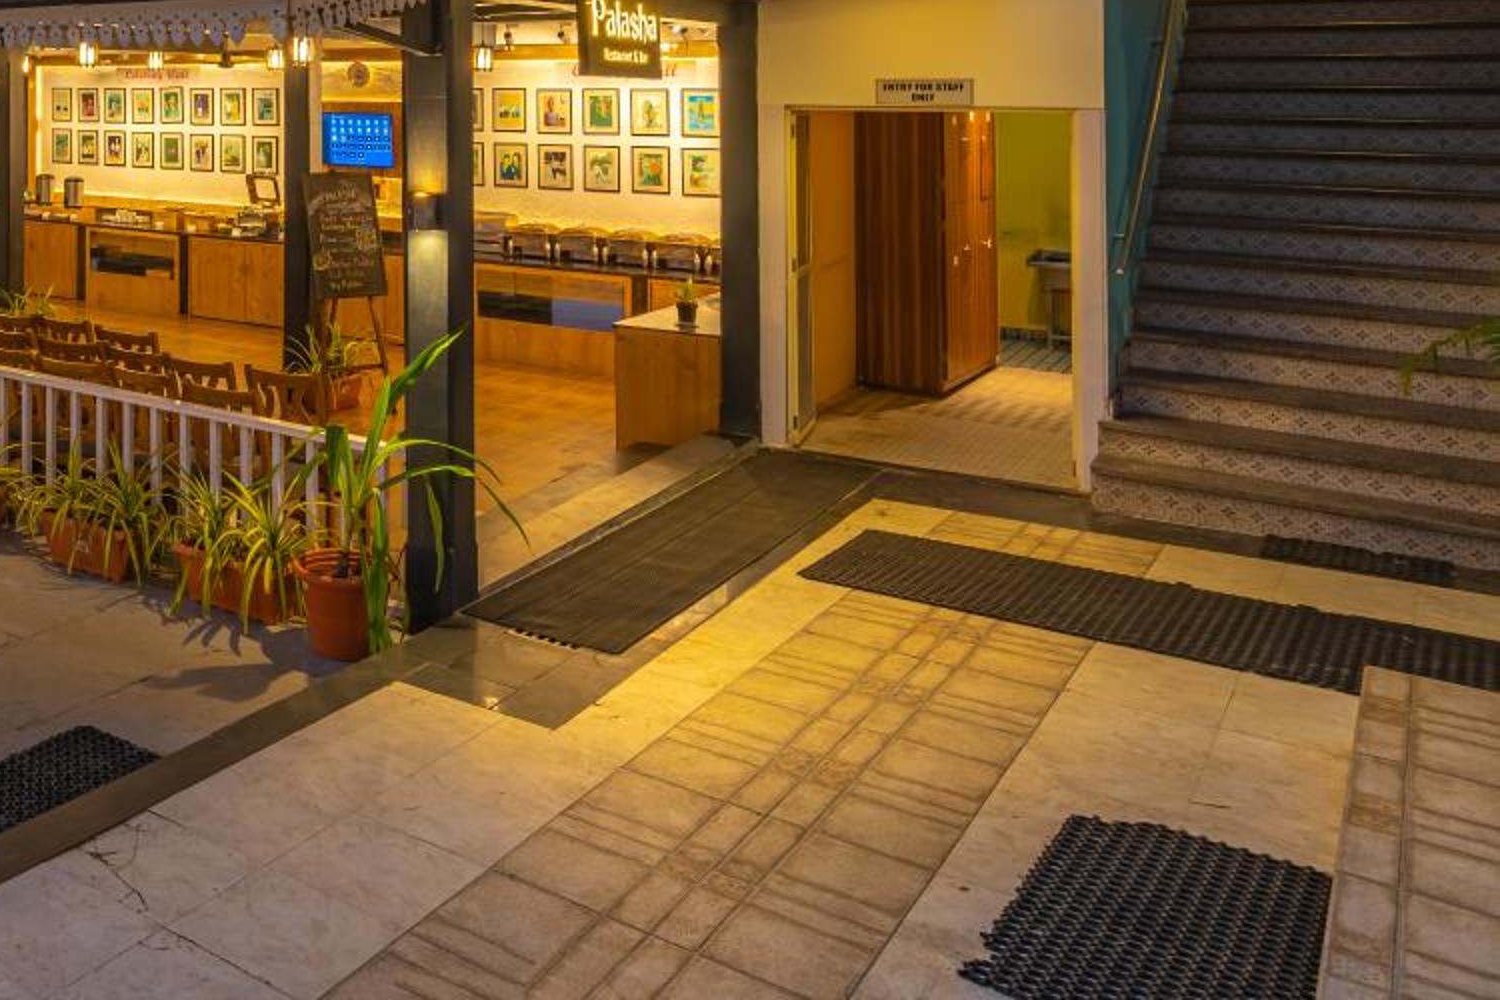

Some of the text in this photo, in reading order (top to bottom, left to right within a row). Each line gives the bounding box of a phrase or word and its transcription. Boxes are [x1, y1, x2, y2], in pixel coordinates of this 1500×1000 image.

[883, 83, 964, 91] ENTRY FOR STAFF
